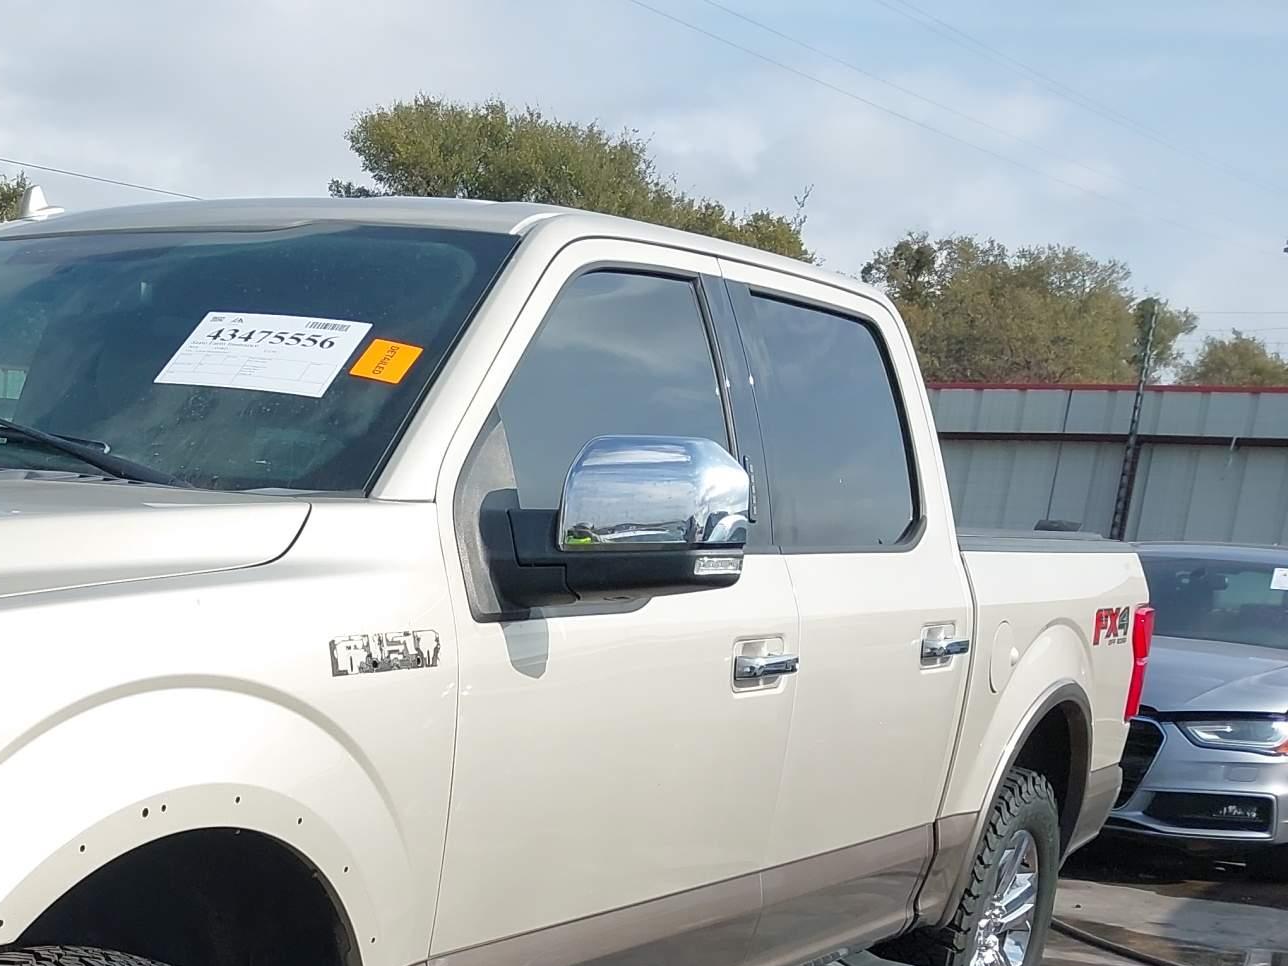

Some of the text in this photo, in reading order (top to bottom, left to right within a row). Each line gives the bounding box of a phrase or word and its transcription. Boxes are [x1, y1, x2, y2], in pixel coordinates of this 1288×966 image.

[206, 327, 339, 350] 43475556
[371, 345, 400, 376] DETAILED
[1092, 606, 1130, 647] FX4
